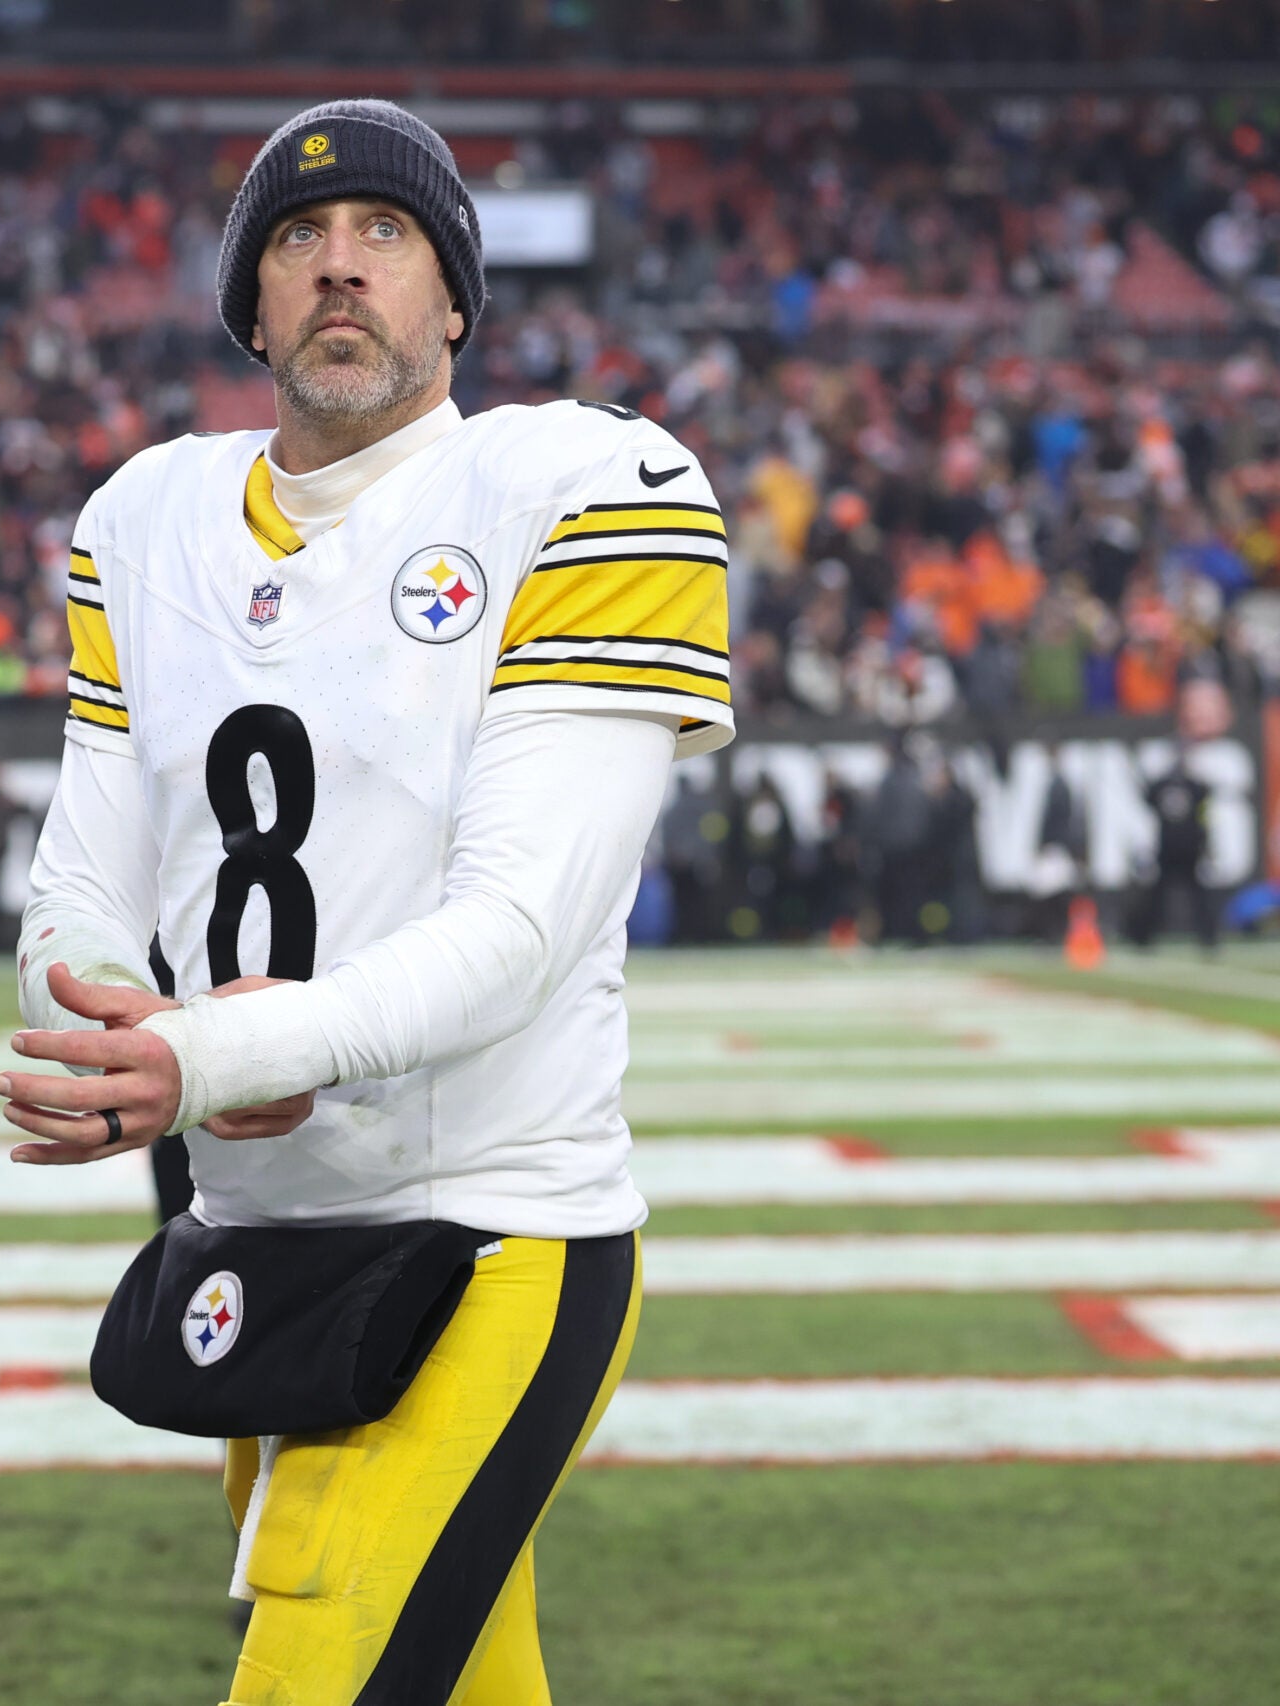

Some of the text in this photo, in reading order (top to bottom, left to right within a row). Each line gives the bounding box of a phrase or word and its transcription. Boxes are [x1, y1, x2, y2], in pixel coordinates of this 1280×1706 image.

[299, 157, 336, 171] STEELERS
[401, 586, 437, 597] Steelers
[251, 601, 274, 619] NFL
[206, 703, 317, 988] 8
[189, 1309, 210, 1321] Steelers
